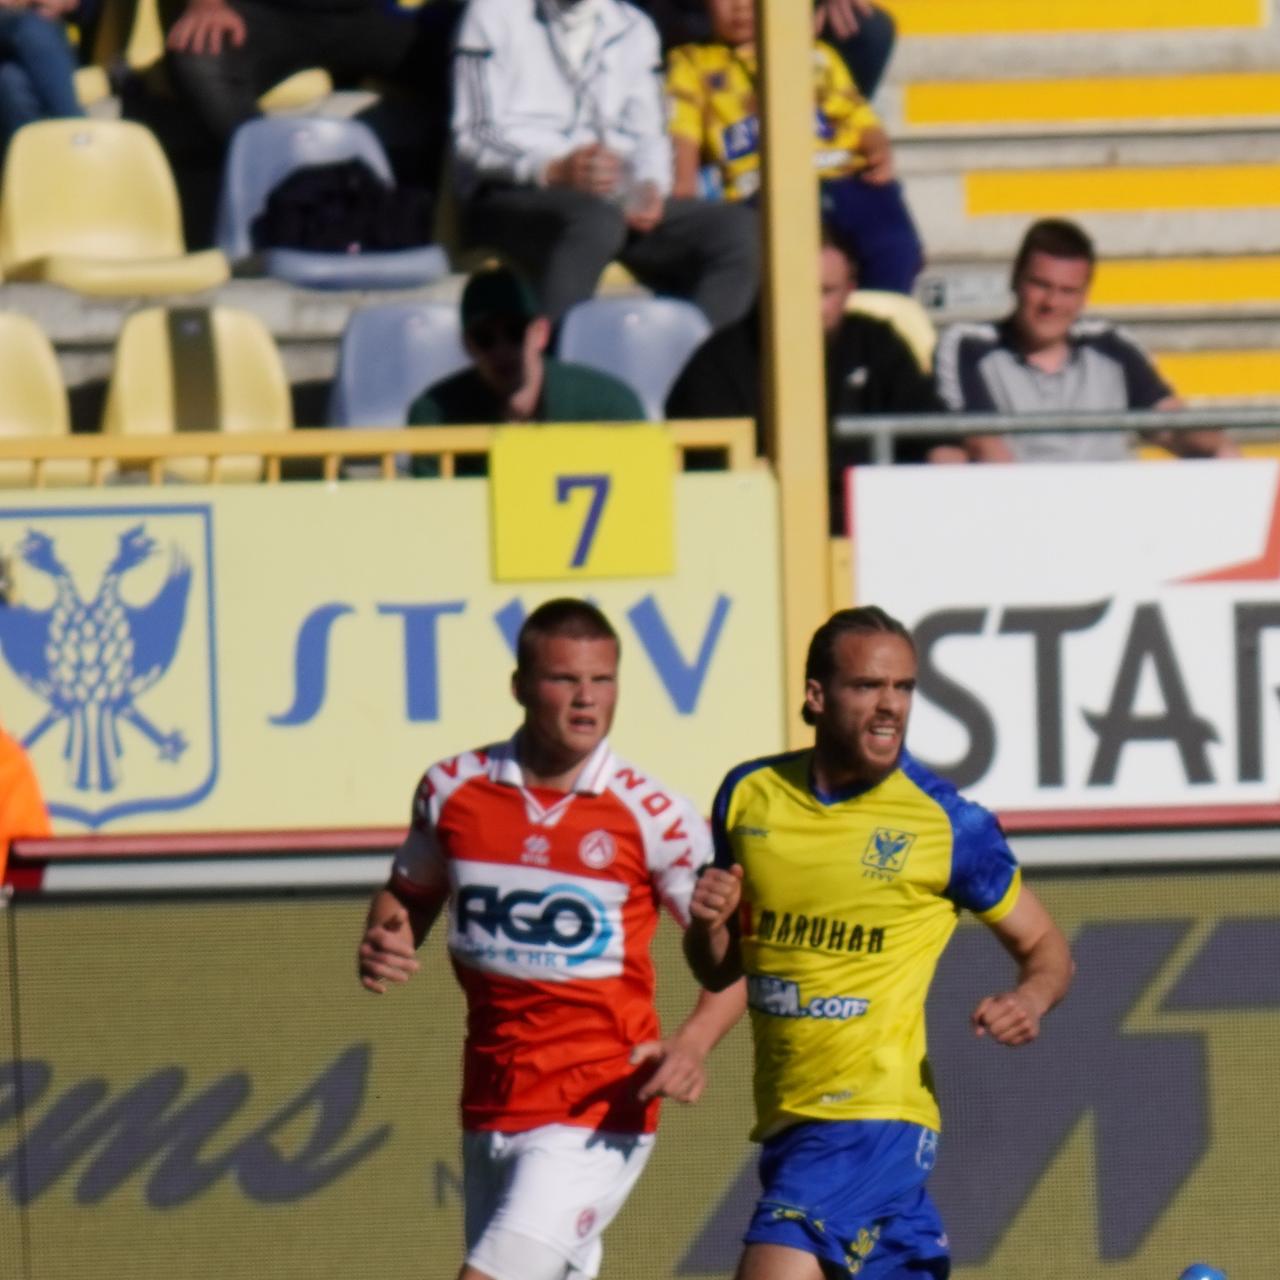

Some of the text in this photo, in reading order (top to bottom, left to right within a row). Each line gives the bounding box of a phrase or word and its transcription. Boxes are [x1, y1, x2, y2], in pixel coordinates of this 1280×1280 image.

[555, 474, 611, 568] 7
[457, 885, 595, 948] AGO
[759, 909, 885, 953] MARUHAN
